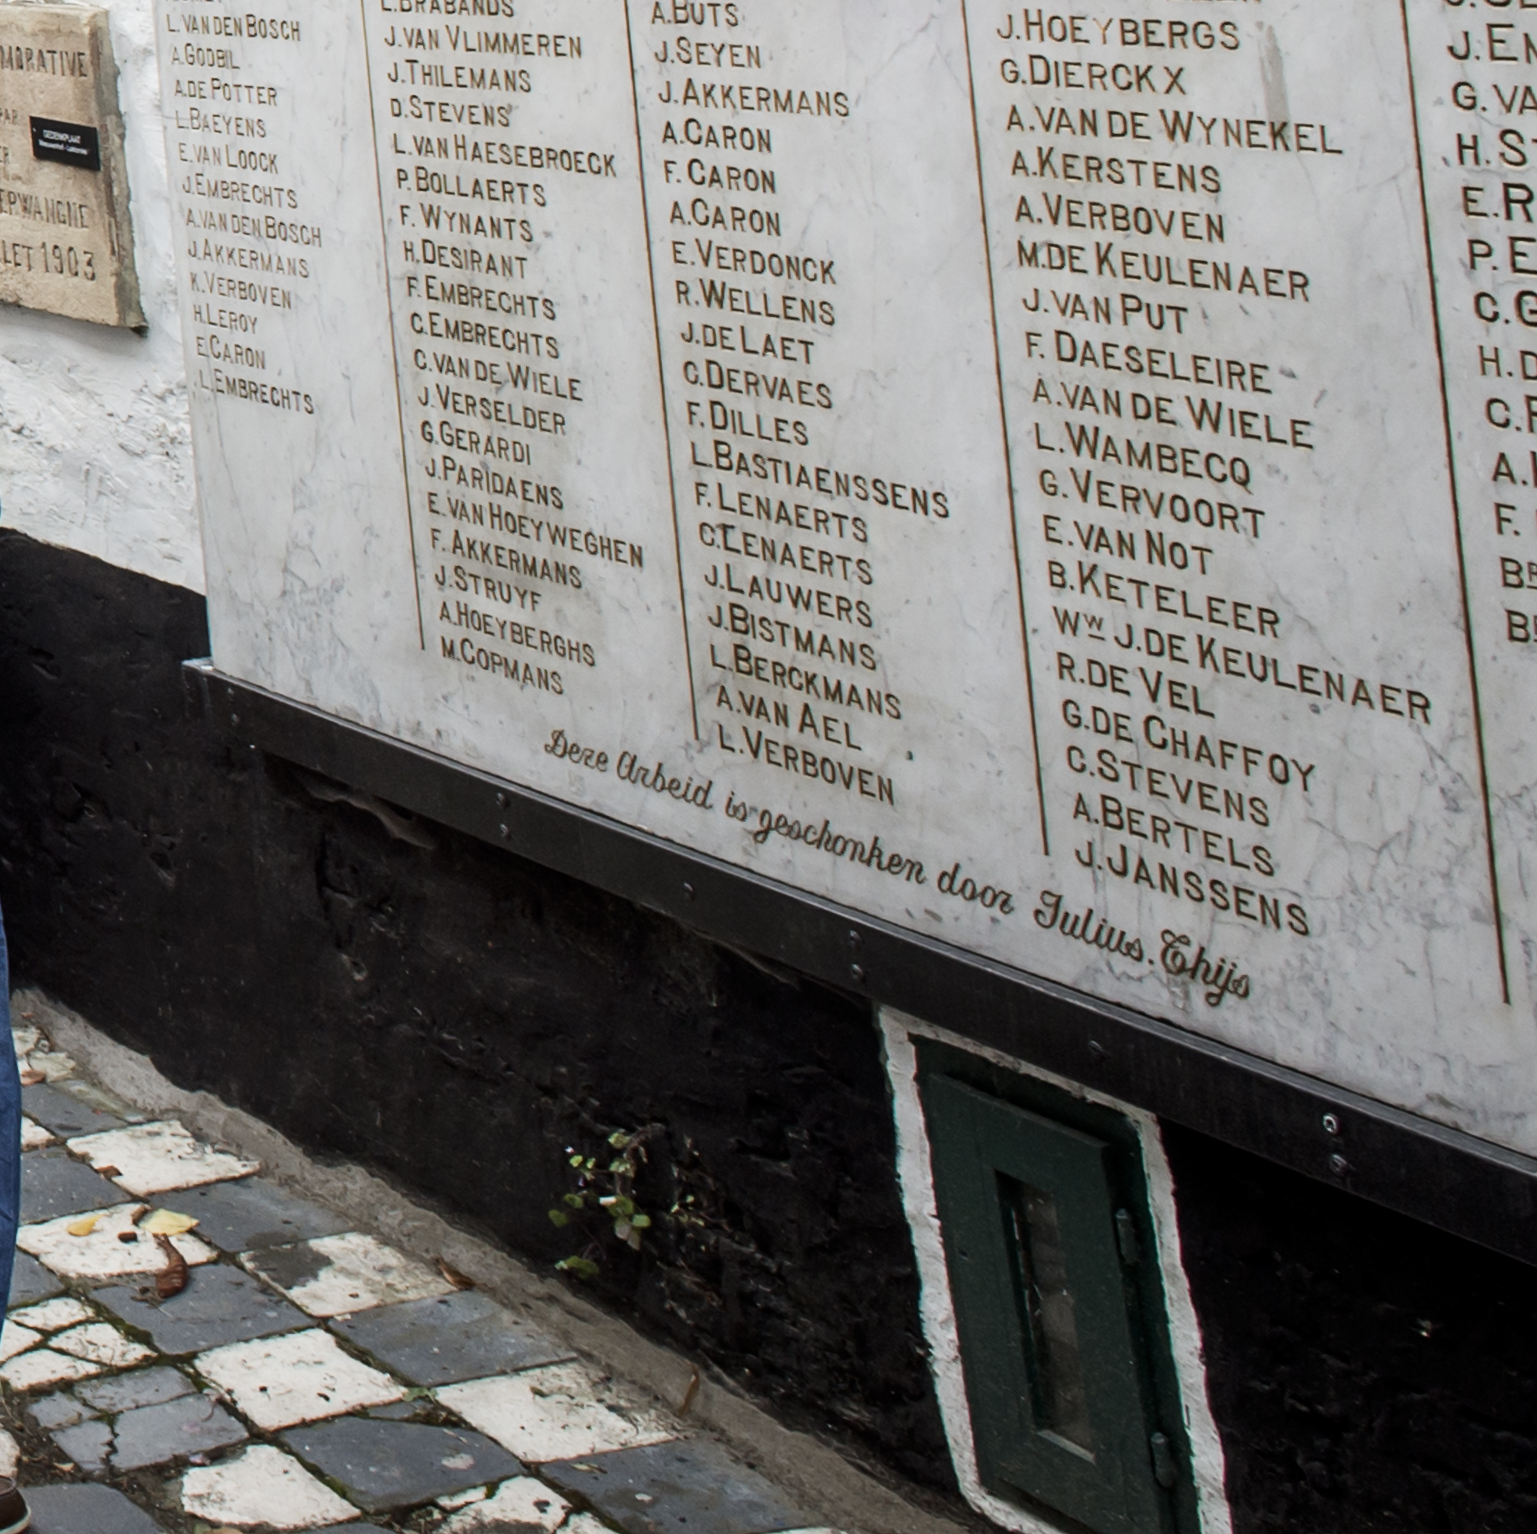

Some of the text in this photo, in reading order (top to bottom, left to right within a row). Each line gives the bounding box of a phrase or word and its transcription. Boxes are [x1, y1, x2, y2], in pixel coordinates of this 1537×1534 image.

[41, 241, 96, 281] 1903
[1094, 248, 1311, 307] KEULENAER
[1119, 297, 1191, 339] PUT
[739, 327, 816, 368] LAET
[1139, 669, 1215, 721] VEL
[795, 703, 861, 751] AEL
[1142, 716, 1317, 796] CHAFFOY
[617, 752, 713, 810] Arbeid
[754, 810, 927, 886] geschonken
[937, 863, 1014, 915] door
